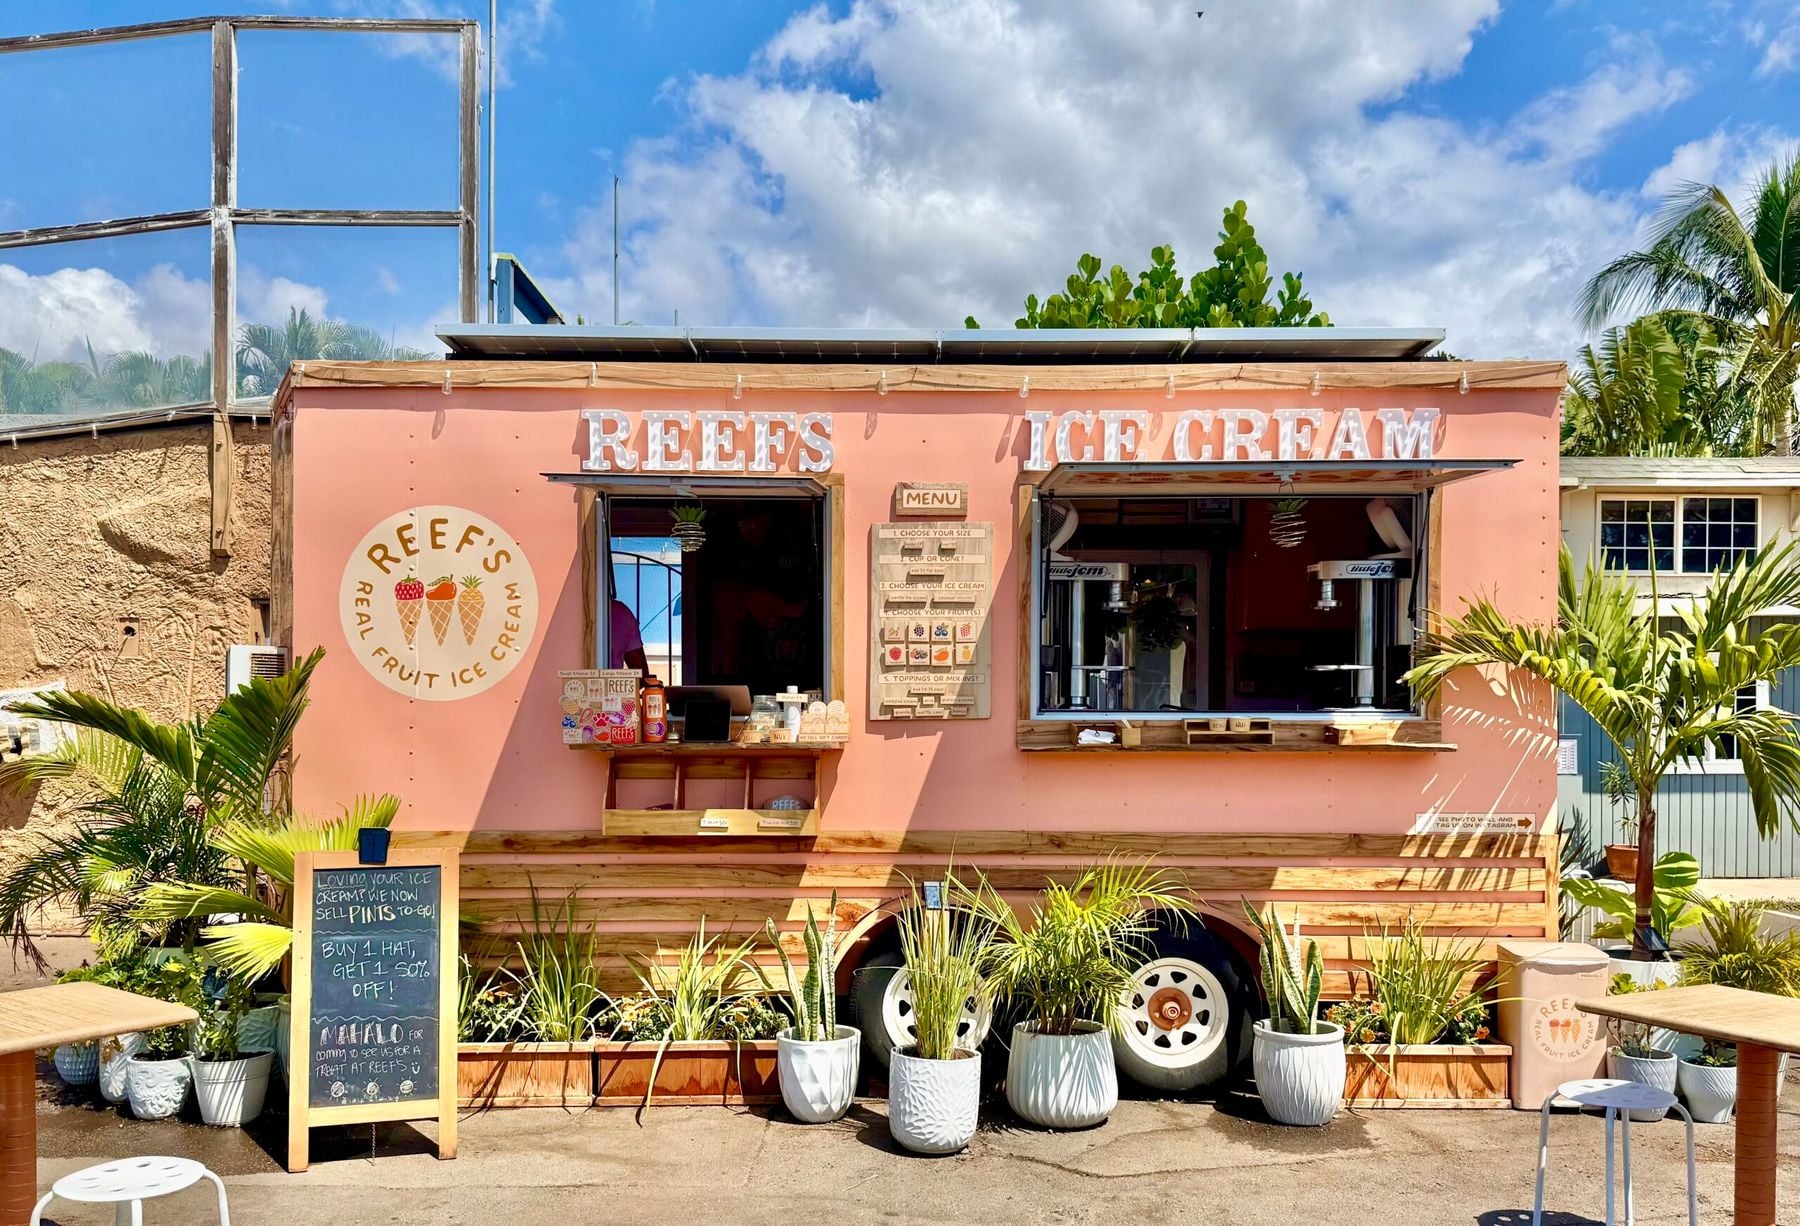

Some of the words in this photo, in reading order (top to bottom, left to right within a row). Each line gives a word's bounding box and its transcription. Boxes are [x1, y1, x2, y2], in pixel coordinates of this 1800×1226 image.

[581, 409, 835, 472] REEFS
[1023, 409, 1148, 471] ICE
[1173, 408, 1441, 461] CREAM
[906, 492, 958, 505] MENU
[367, 518, 512, 575] REEF'S
[355, 580, 374, 641] REAL
[490, 582, 522, 662] CREAM
[371, 646, 440, 689] FRUIT
[451, 662, 487, 688] ICE
[409, 871, 433, 884] ICE
[316, 888, 365, 905] CREAM?
[368, 889, 388, 902] WE
[391, 888, 418, 902] NOW
[315, 906, 348, 920] SELL
[349, 904, 396, 924] PINTS
[321, 941, 357, 964] BUY
[363, 940, 377, 956] 1
[332, 960, 371, 980] GET
[373, 961, 388, 975] 1
[320, 1021, 404, 1046] MAHALO
[409, 1029, 424, 1041] FOR
[1582, 1020, 1595, 1050] CREAM
[413, 1045, 421, 1055] A
[1541, 1043, 1566, 1059] FRUIT
[1568, 1050, 1581, 1058] ICE
[315, 1063, 348, 1078] TREAT
[351, 1061, 366, 1074] AT
